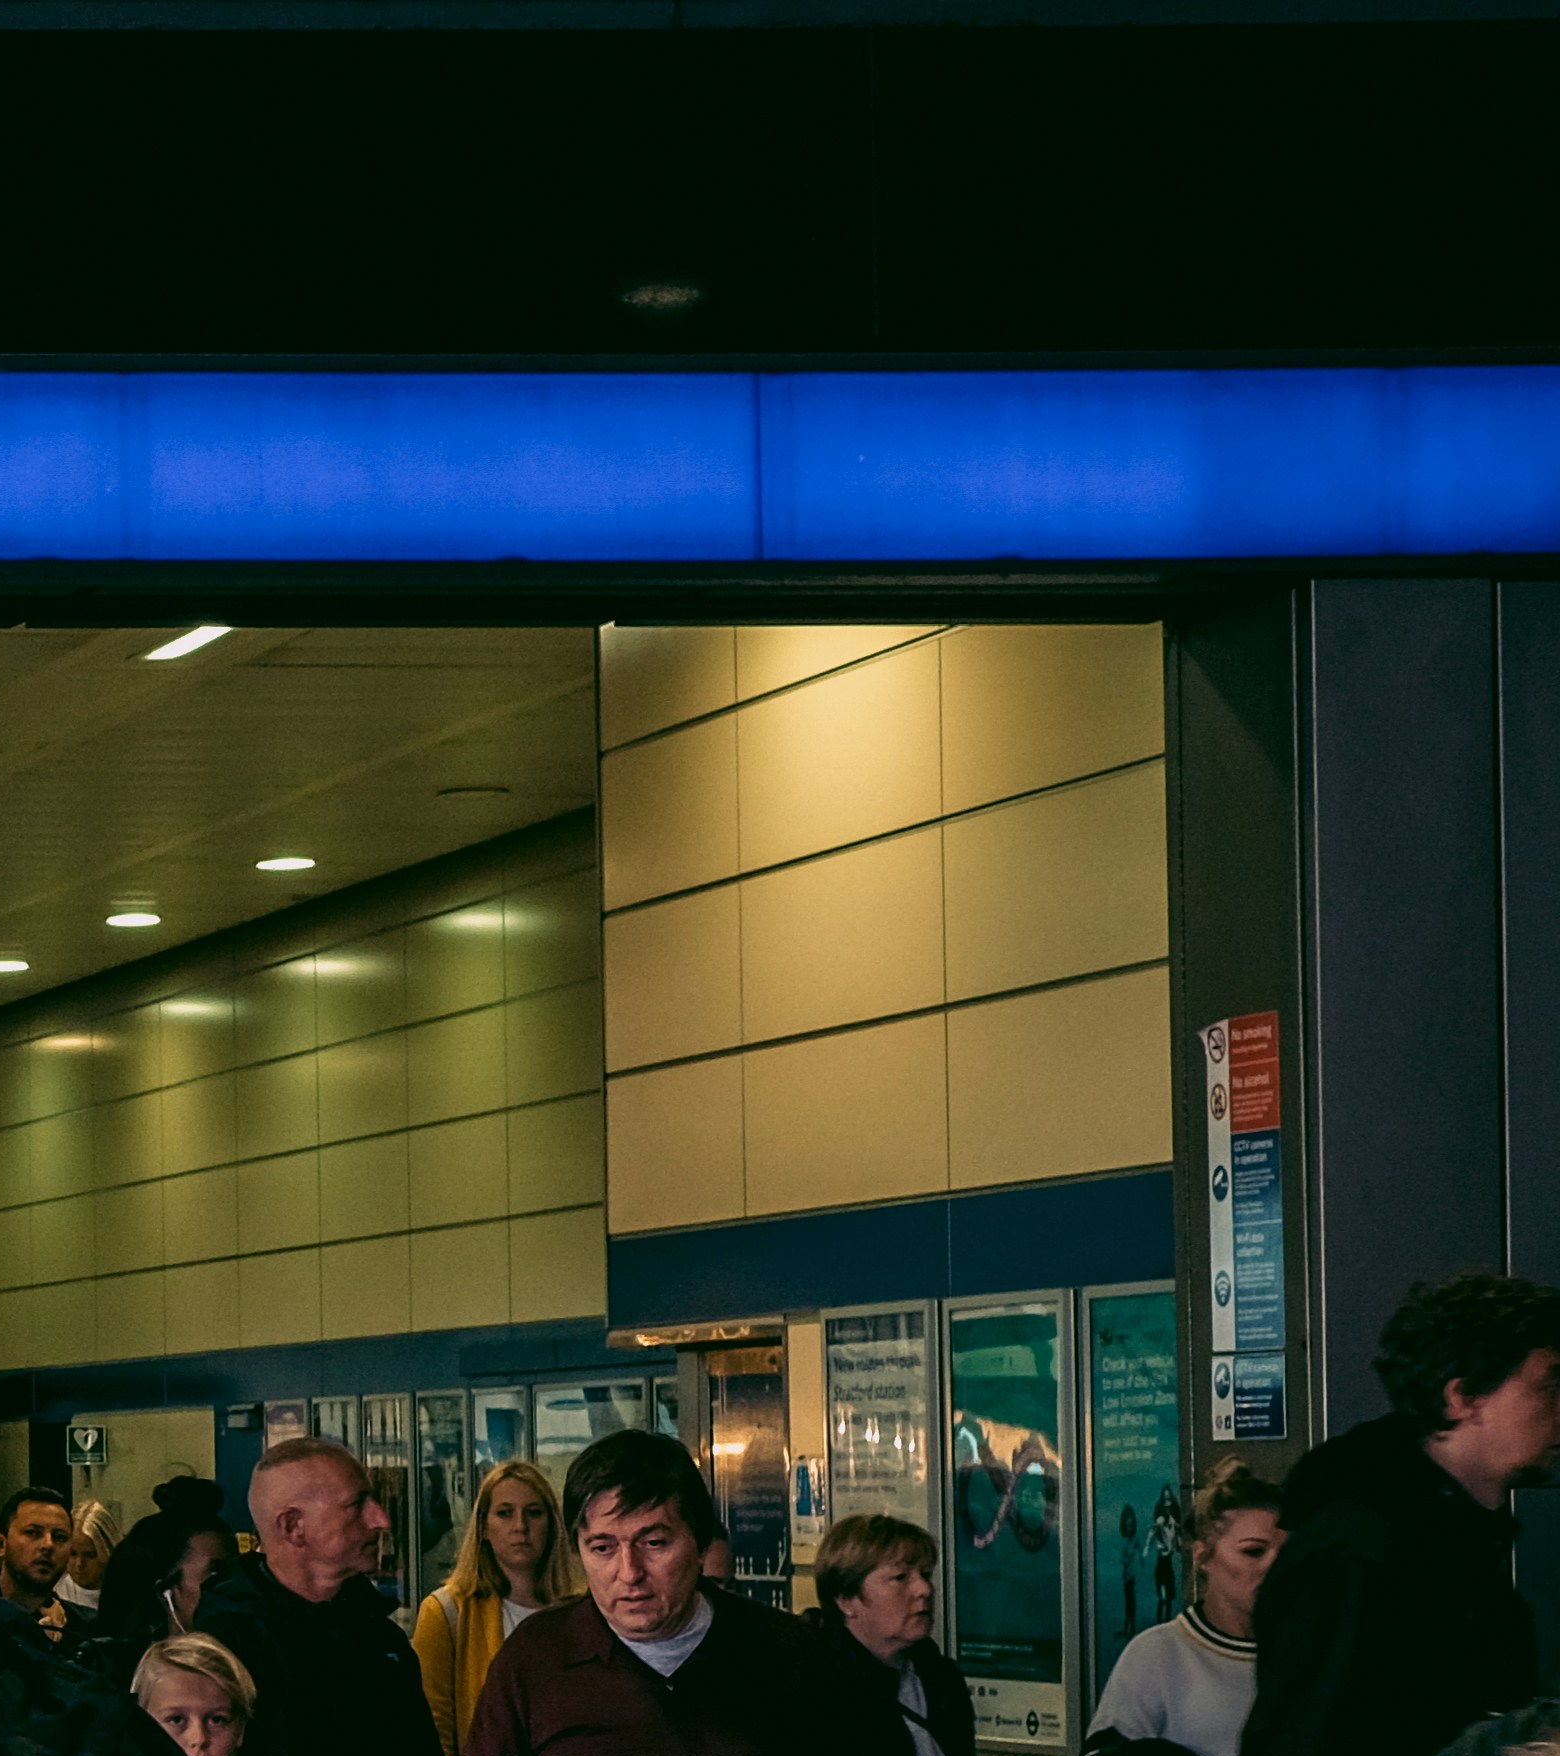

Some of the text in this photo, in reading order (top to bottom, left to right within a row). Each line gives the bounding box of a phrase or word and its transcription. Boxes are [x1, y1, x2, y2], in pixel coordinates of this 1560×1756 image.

[1231, 1025, 1272, 1040] No smoking
[1244, 1072, 1270, 1087] alcohol
